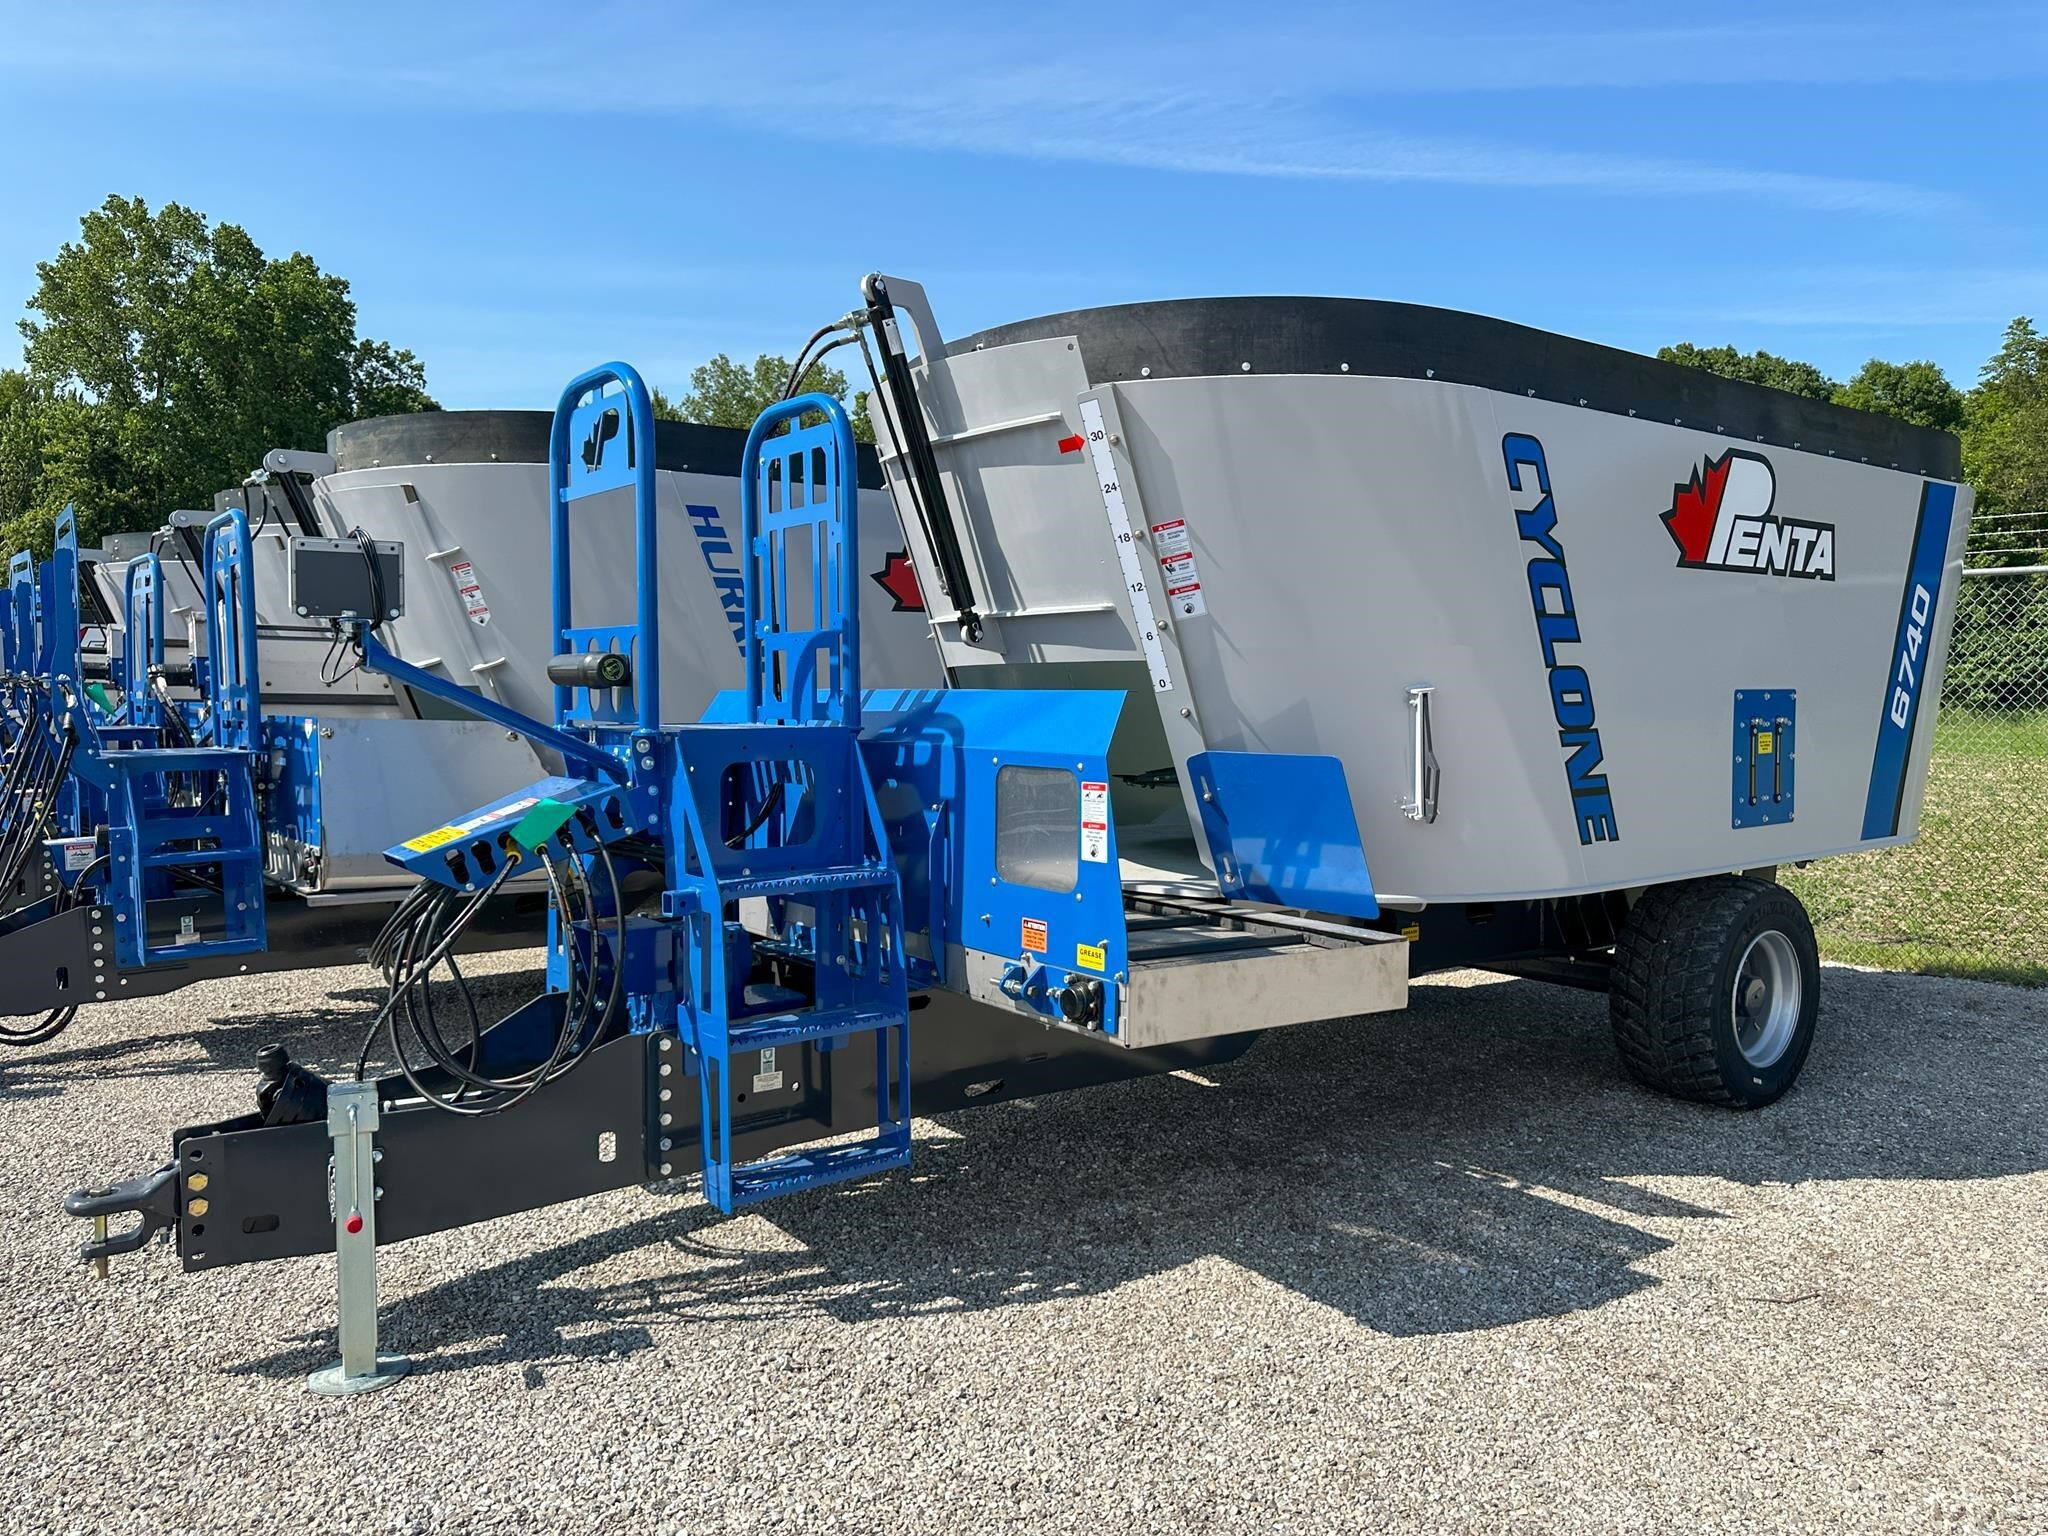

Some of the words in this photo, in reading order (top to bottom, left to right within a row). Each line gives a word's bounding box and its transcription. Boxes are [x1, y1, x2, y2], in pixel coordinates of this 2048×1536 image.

[1090, 430, 1104, 441] 30
[1104, 482, 1117, 493] 24
[1704, 455, 1833, 576] PENTA
[1118, 533, 1131, 543] 18
[1131, 582, 1144, 592] 12
[1146, 632, 1153, 641] 6
[1502, 432, 1619, 845] CYCLONE
[1890, 584, 1930, 729] 6740
[1159, 679, 1166, 688] 0
[1079, 948, 1102, 960] GREASE
